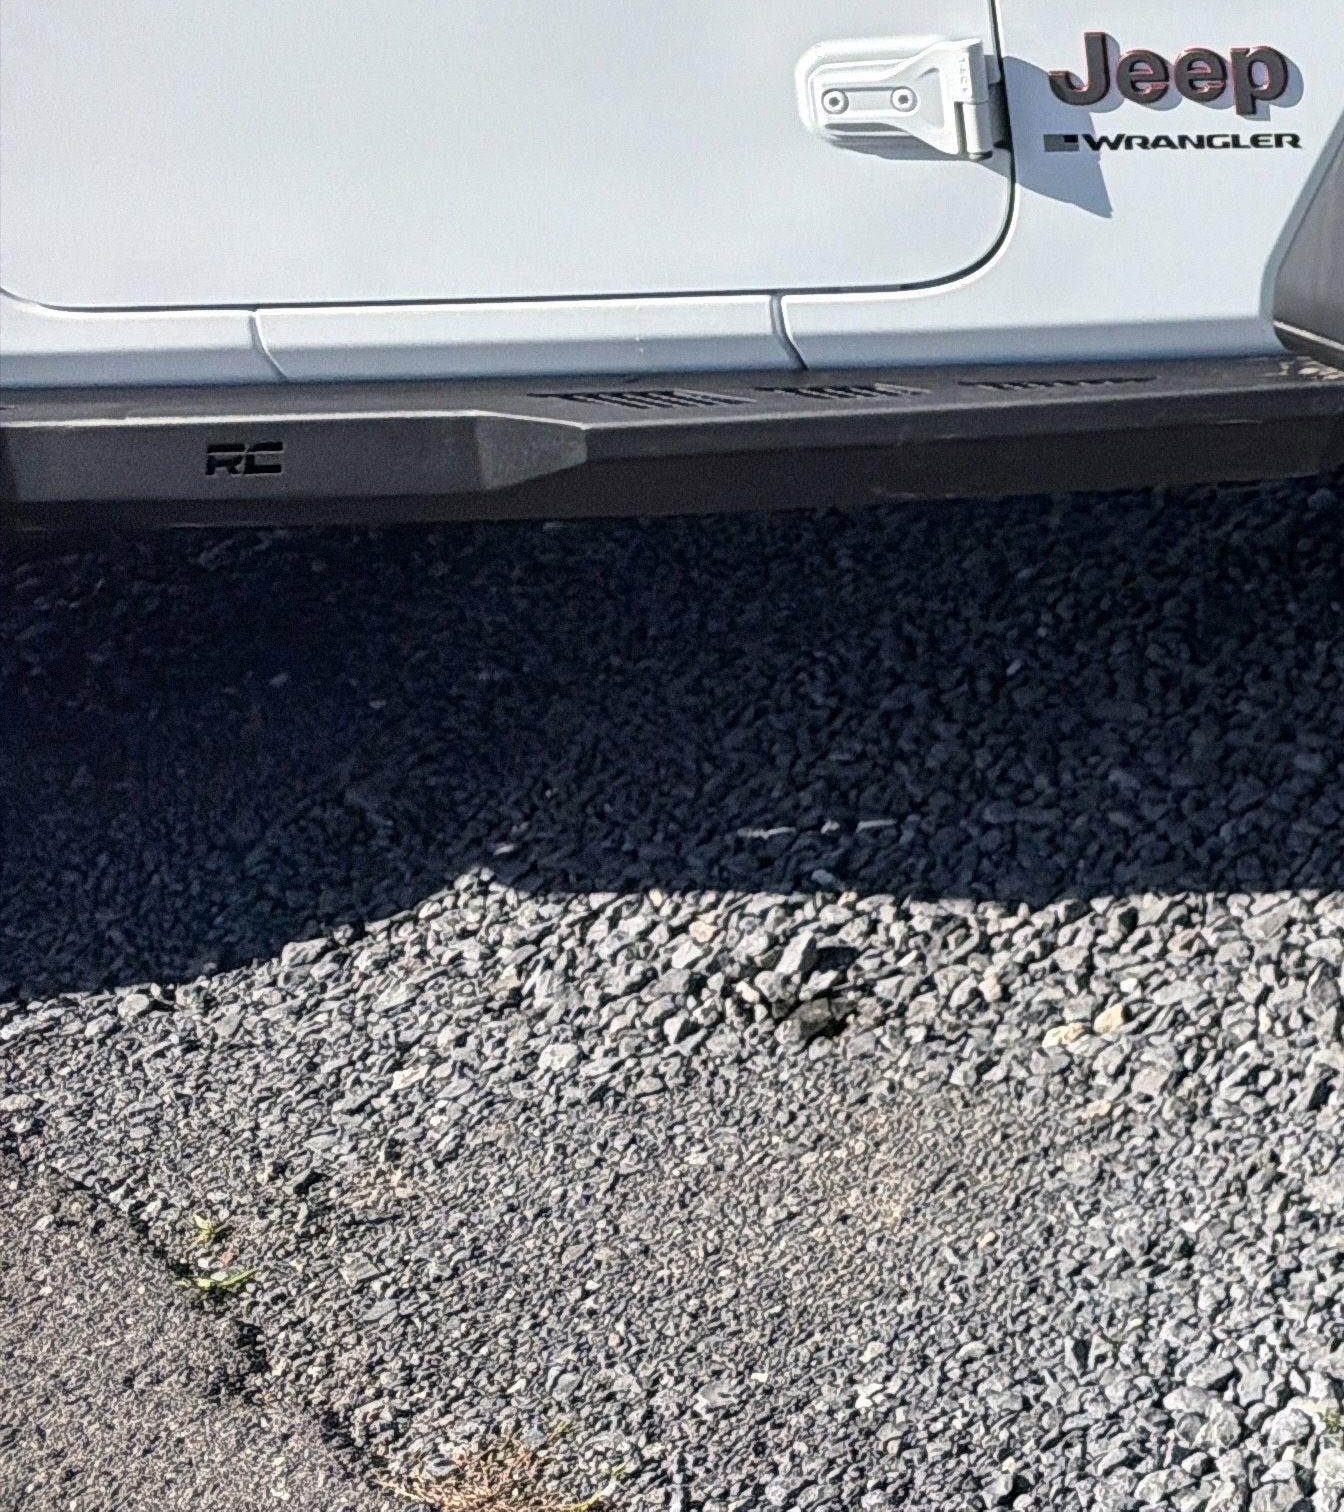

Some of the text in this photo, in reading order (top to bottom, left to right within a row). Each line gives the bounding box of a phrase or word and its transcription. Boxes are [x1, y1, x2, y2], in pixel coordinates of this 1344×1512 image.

[1048, 31, 1288, 115] Jeep
[1081, 133, 1303, 151] WRANGLER
[205, 441, 284, 476] RC
